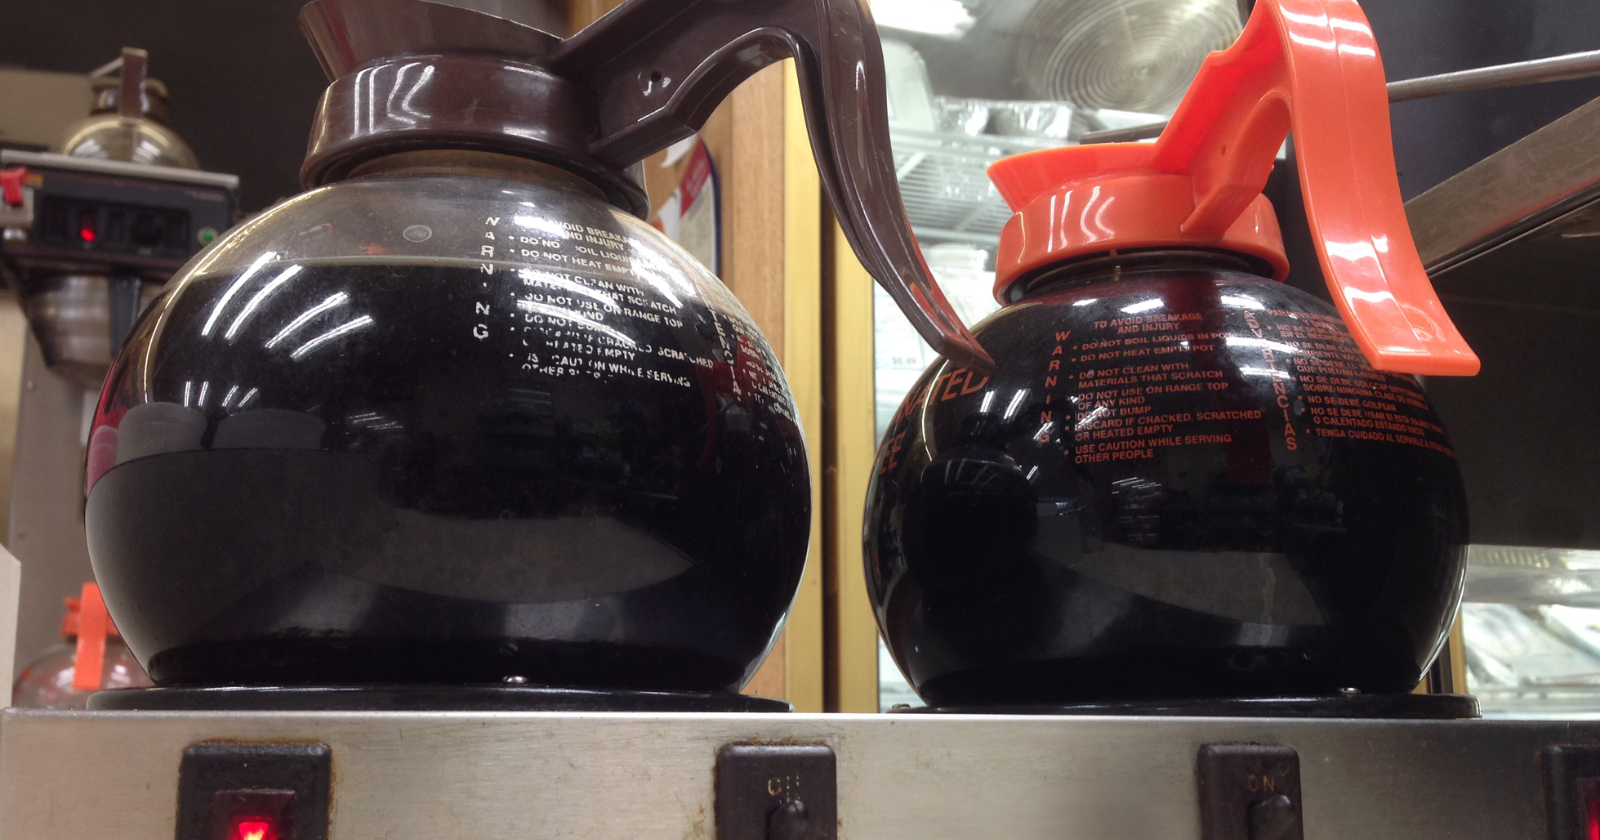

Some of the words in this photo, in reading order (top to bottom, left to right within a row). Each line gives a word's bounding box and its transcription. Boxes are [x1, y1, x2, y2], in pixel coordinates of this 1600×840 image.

[520, 236, 539, 245] DO
[586, 235, 625, 251] INJURY
[521, 249, 539, 258] DO
[543, 252, 568, 262] NOT
[572, 257, 602, 270] HEAT
[547, 295, 572, 306] NOT
[624, 309, 661, 324] RANGE
[664, 316, 684, 329] TOP
[1093, 320, 1107, 329] TO
[1110, 317, 1143, 327] AVOID
[1146, 313, 1203, 323] BREAKAGE
[1117, 324, 1139, 334] AND
[1142, 322, 1180, 332] INJURY
[1276, 324, 1290, 332] NO
[1293, 325, 1305, 333] SE
[1082, 342, 1097, 350] DO
[1100, 339, 1122, 348] NOT
[1152, 333, 1194, 342] LIQUIDS
[1295, 331, 1306, 339] EL
[1080, 354, 1096, 362] DO
[1098, 352, 1121, 360] NOT
[1123, 348, 1150, 357] HEAT
[1154, 345, 1190, 354] EMPTY
[1192, 344, 1215, 352] POT
[1302, 341, 1314, 349] SE
[1315, 342, 1337, 352] DEBE
[1079, 371, 1095, 380] DO
[1097, 368, 1120, 377] NOT
[1122, 365, 1159, 375] CLEAN
[1160, 362, 1189, 371] WITH
[1297, 366, 1319, 374] QUE
[1323, 360, 1344, 369] DEBE
[1078, 375, 1138, 389] MATERIALS
[1141, 373, 1168, 382] THAT
[1171, 370, 1223, 380] SCRATCH
[1300, 376, 1315, 384] NO
[1316, 376, 1329, 384] SE
[1330, 377, 1353, 387] DEBE
[1078, 392, 1093, 401] DO
[1096, 389, 1119, 399] NOT
[1121, 387, 1142, 396] USE
[1146, 385, 1163, 394] ON
[1165, 383, 1203, 393] RANGE
[1207, 382, 1229, 391] TOP
[1303, 384, 1336, 393] SOBRE
[1336, 386, 1374, 398] NINGUNA
[1374, 391, 1398, 403] CLASE
[1078, 402, 1092, 411] OF
[1094, 399, 1116, 408] ANY
[1118, 396, 1146, 405] KIND
[1119, 406, 1152, 415] BUMP
[1307, 395, 1323, 404] NO
[1323, 396, 1338, 405] SE
[1338, 397, 1361, 408] DEBE
[1362, 400, 1397, 412] GOLPEAR
[1075, 419, 1122, 432] DISCARD
[1125, 418, 1135, 427] IF
[1196, 410, 1262, 422] SCRATCHED
[1310, 407, 1325, 416] NO
[1326, 407, 1340, 416] SE
[1340, 408, 1363, 418] DEBE
[1386, 413, 1394, 421] SI
[1313, 416, 1321, 425] O
[1322, 416, 1374, 428] CALENTADO
[1374, 421, 1407, 433] ESTANDO
[1075, 432, 1090, 442] OR
[1092, 427, 1134, 440] HEATED
[1137, 424, 1174, 434] EMPTY
[1316, 428, 1347, 438] TENGA
[1348, 430, 1385, 441] CUIDADO
[1386, 434, 1396, 443] AL
[1075, 445, 1096, 455] USE
[1098, 439, 1146, 452] CAUTION
[1148, 436, 1182, 447] WHILE
[1184, 434, 1232, 445] SERVING
[1074, 452, 1110, 464] OTHER
[1112, 449, 1154, 461] PEOPLE
[1248, 774, 1275, 792] ON
